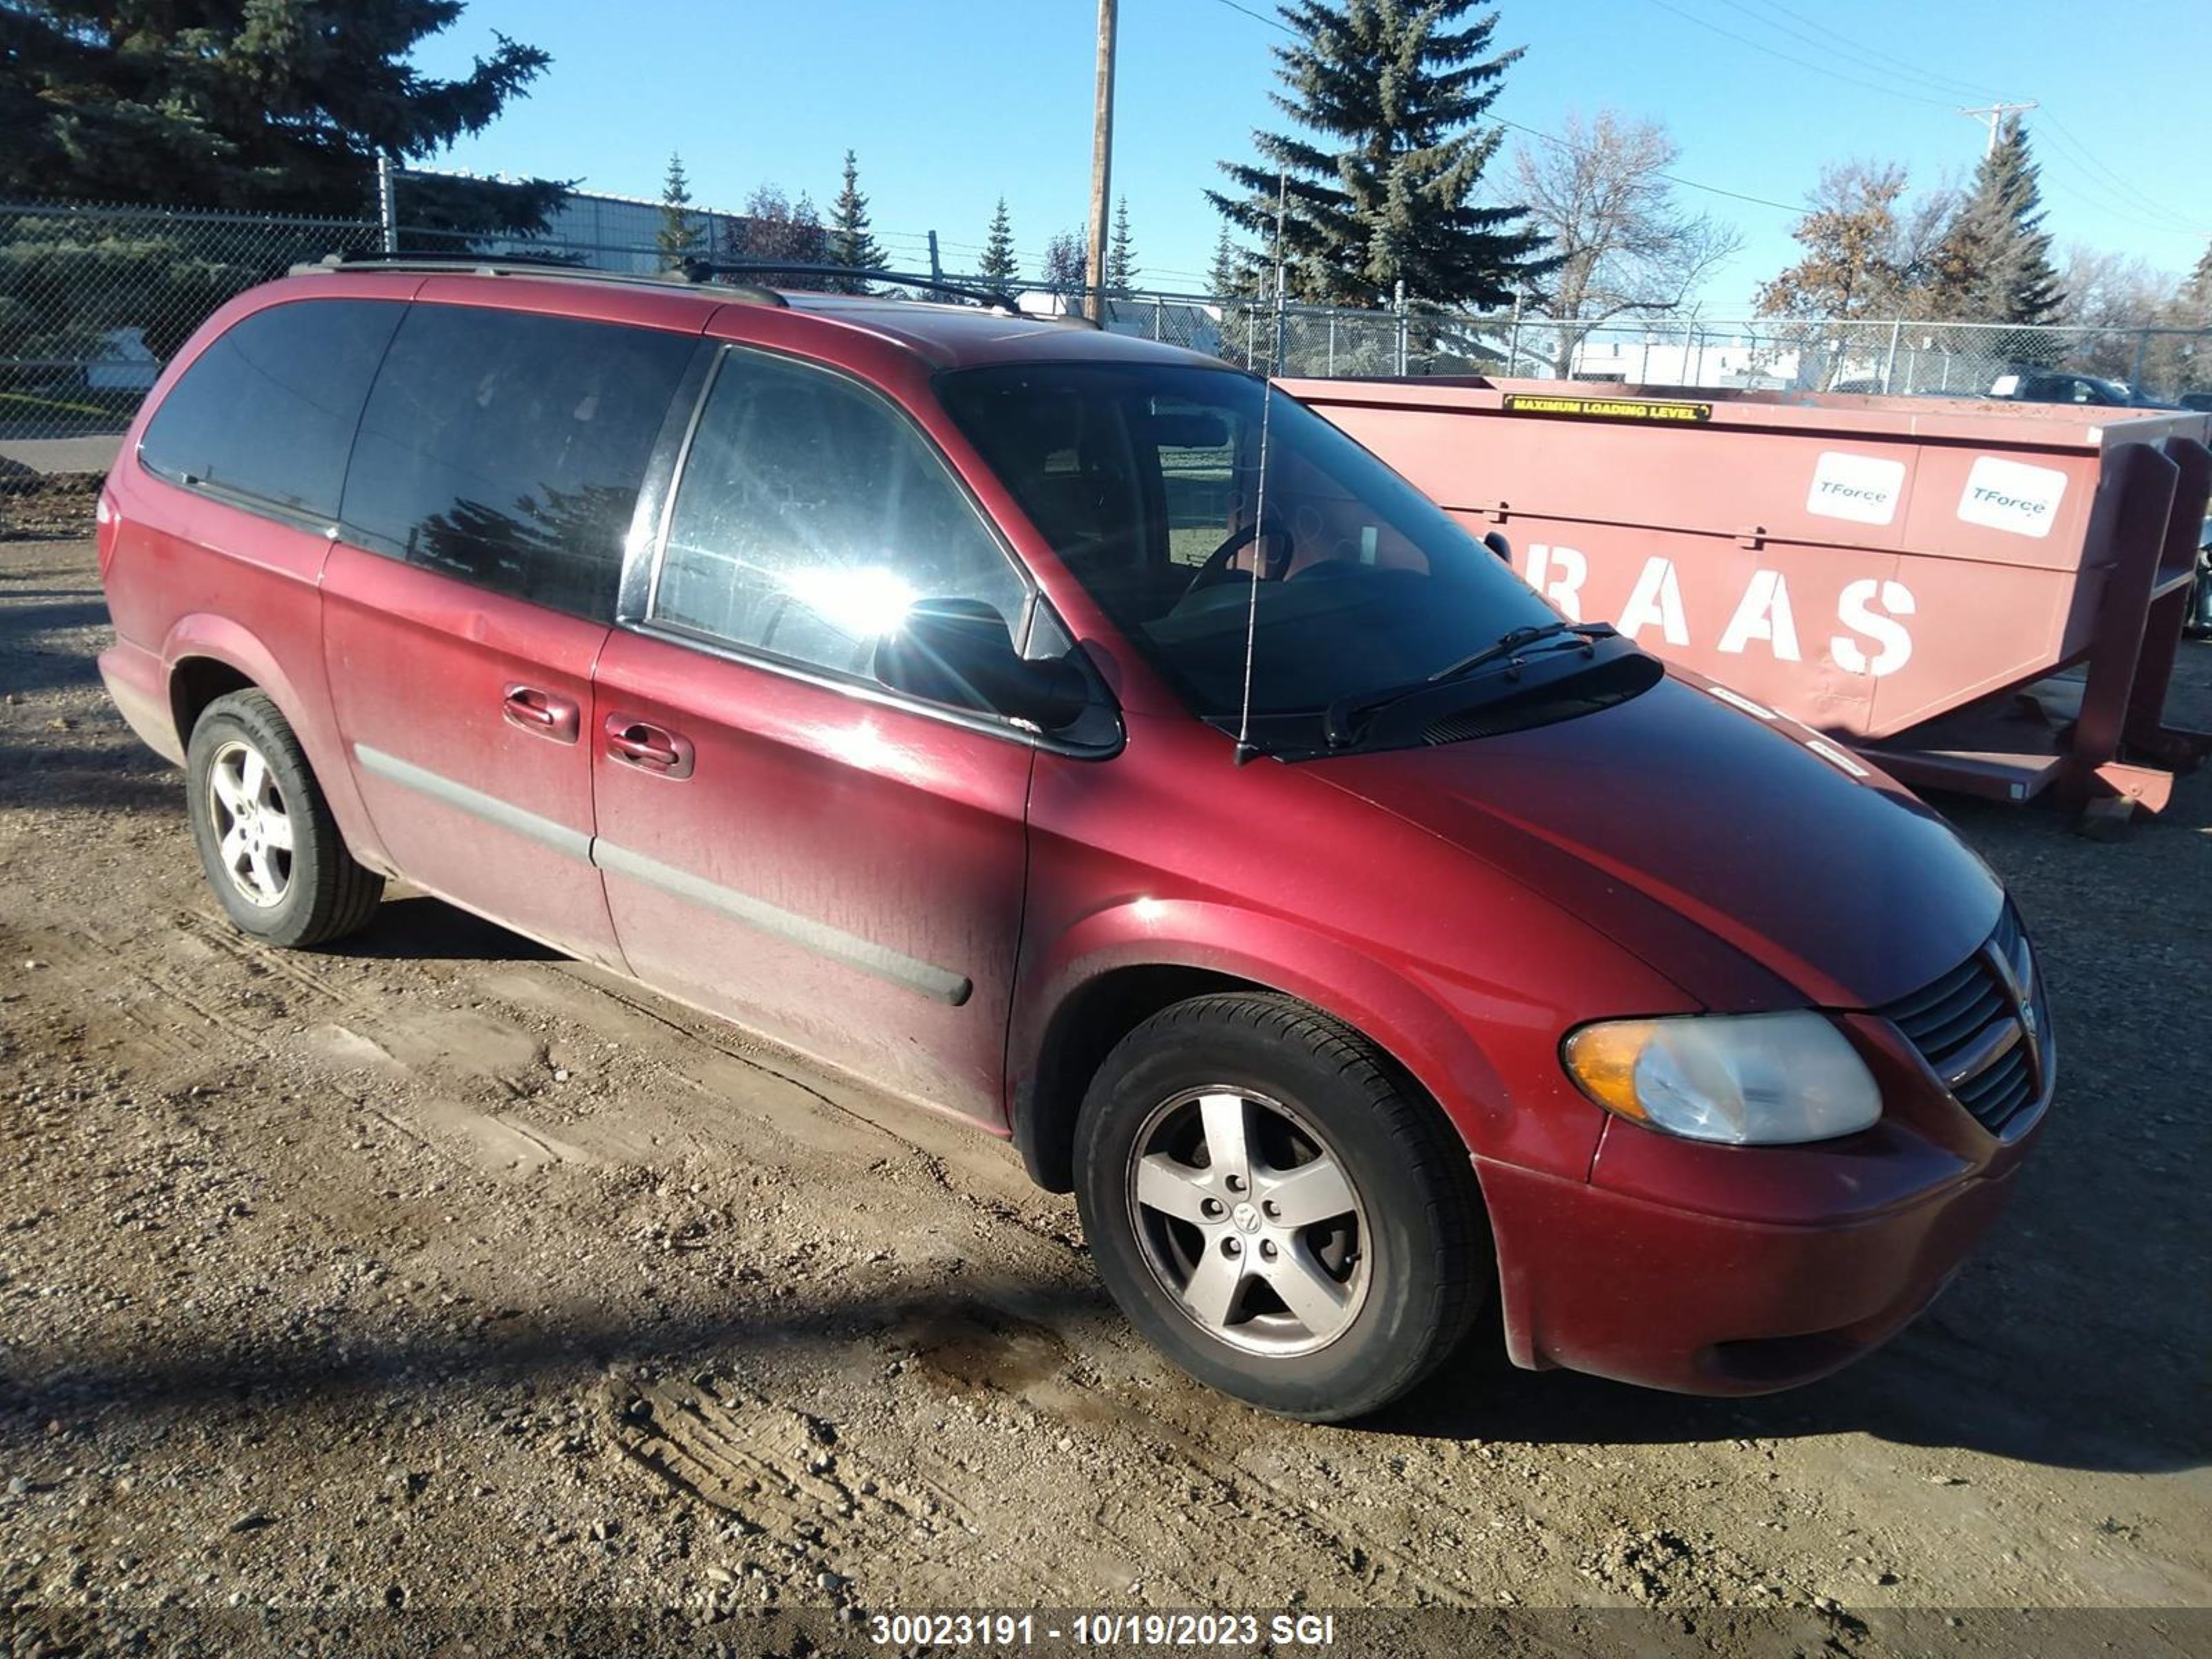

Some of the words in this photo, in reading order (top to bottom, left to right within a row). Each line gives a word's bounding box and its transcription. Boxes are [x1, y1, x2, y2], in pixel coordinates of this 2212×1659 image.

[1513, 400, 1581, 413] MAXIMUM
[1583, 402, 1647, 418] LOADING
[1650, 406, 1697, 420] LEVEL
[1821, 482, 1887, 503] TForce
[1974, 487, 2046, 514] TForce
[1477, 538, 1916, 677] RAAS
